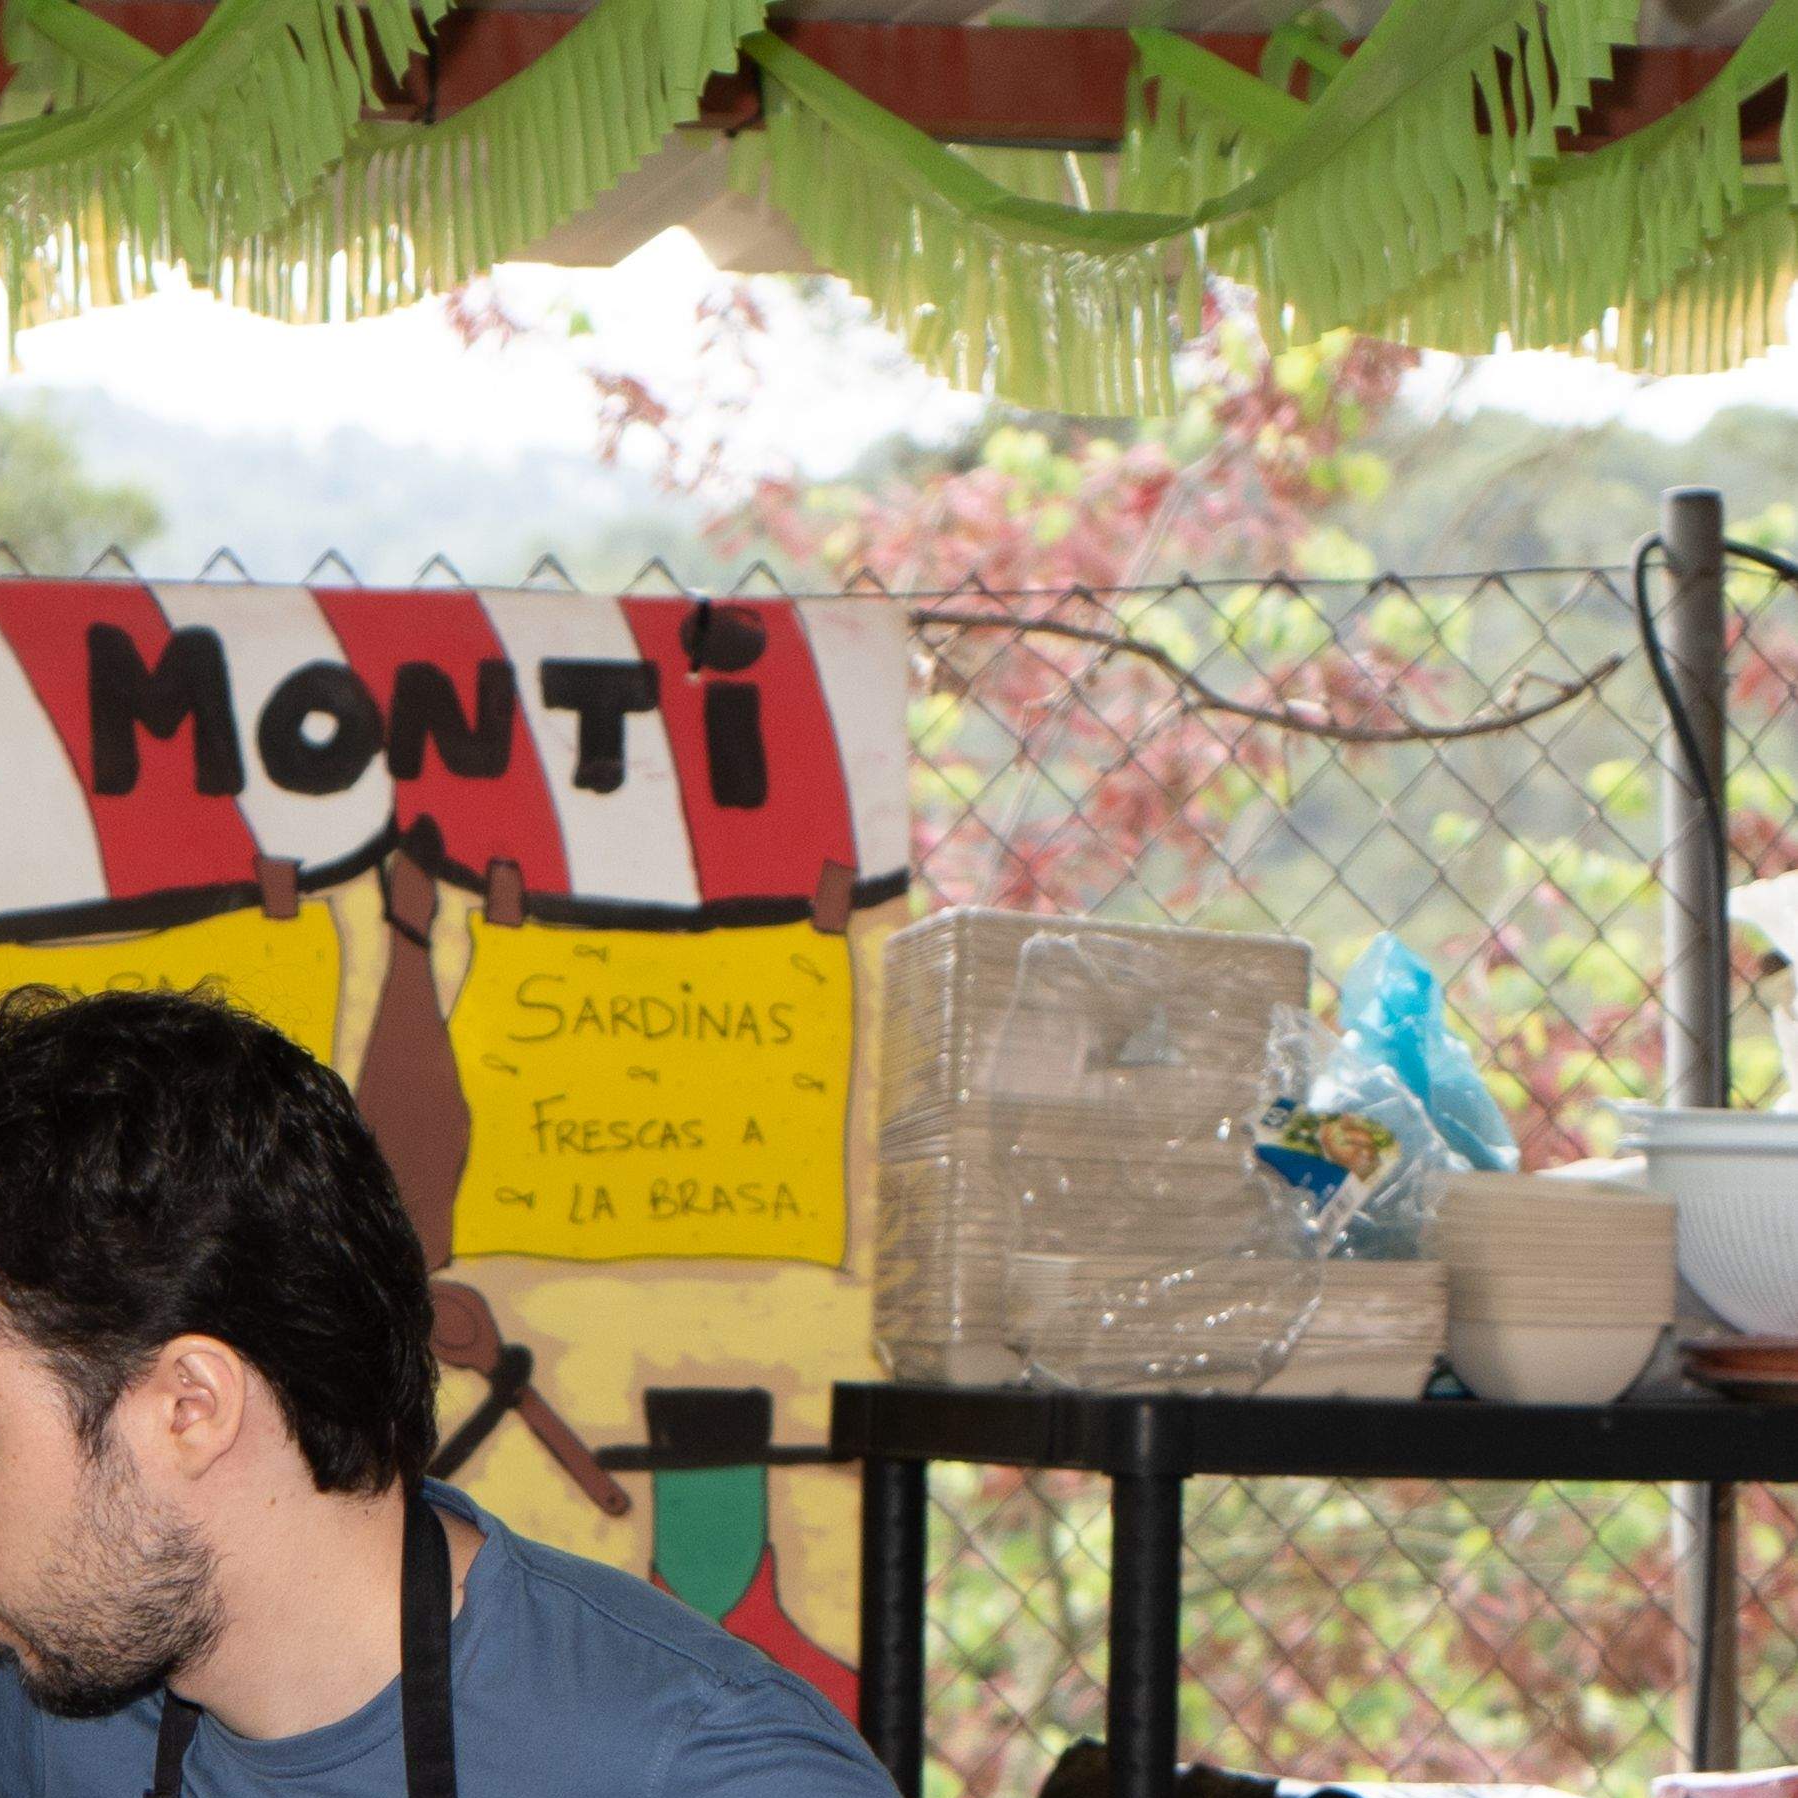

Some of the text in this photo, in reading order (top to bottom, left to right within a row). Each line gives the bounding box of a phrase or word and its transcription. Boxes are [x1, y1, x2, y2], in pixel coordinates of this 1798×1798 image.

[530, 1093, 765, 1154] FRESCAS A
[568, 1182, 617, 1225] LA
